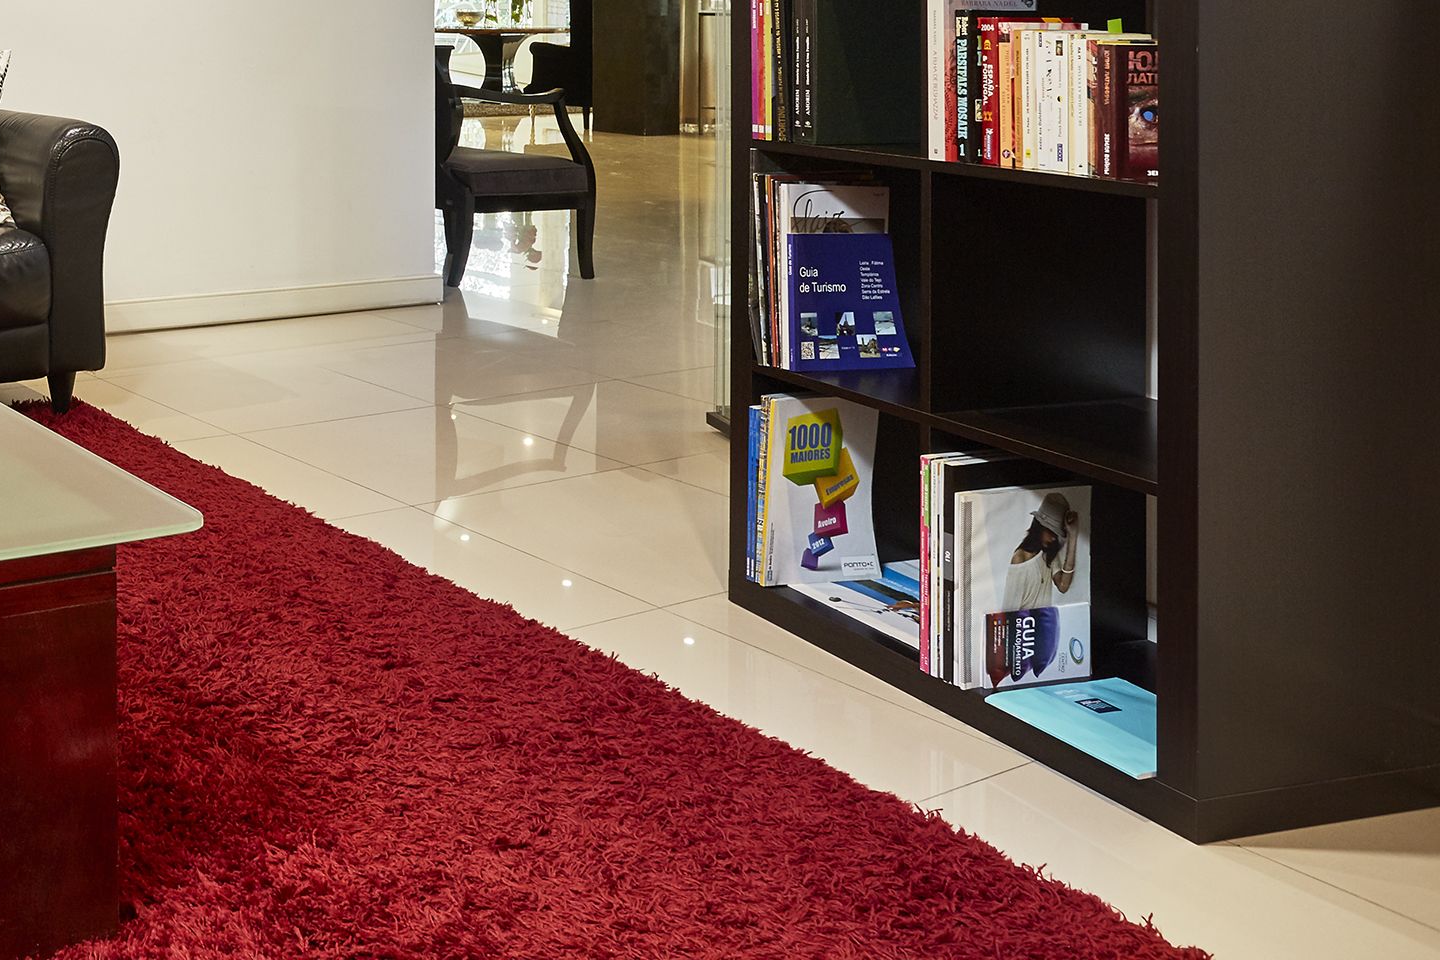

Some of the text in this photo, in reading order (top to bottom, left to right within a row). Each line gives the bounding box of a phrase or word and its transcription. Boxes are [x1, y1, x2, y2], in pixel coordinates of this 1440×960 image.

[961, 0, 991, 7] BARBARA
[957, 39, 968, 139] PARSIFALS MOSAIK
[987, 64, 995, 97] ESPAÑA
[778, 105, 787, 142] SPORTING
[799, 266, 819, 278] Guia
[799, 282, 847, 293] de Turismo
[788, 422, 832, 450] 1000
[790, 447, 831, 464] MAIORES
[817, 516, 837, 528] Aveiro
[1015, 618, 1022, 627] DE
[1021, 616, 1036, 660] GUIA
